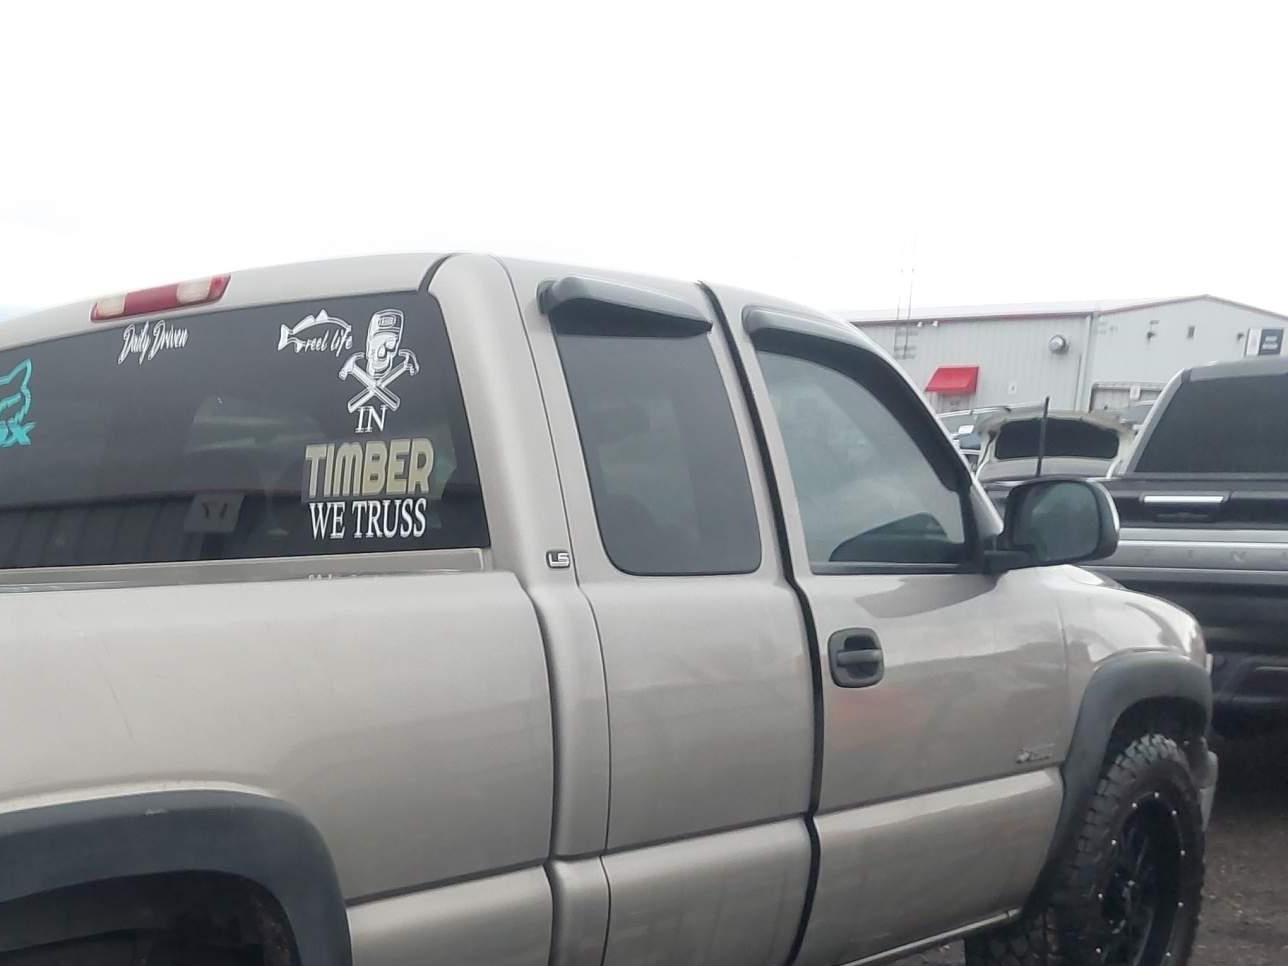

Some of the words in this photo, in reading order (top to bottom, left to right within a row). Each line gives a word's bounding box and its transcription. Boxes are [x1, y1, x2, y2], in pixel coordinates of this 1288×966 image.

[117, 320, 151, 366] Daily
[148, 319, 189, 361] Driven
[355, 404, 387, 433] IN
[305, 437, 434, 498] TIMBER
[309, 501, 346, 540] WE
[352, 498, 427, 538] TRUSS
[547, 551, 570, 568] LS
